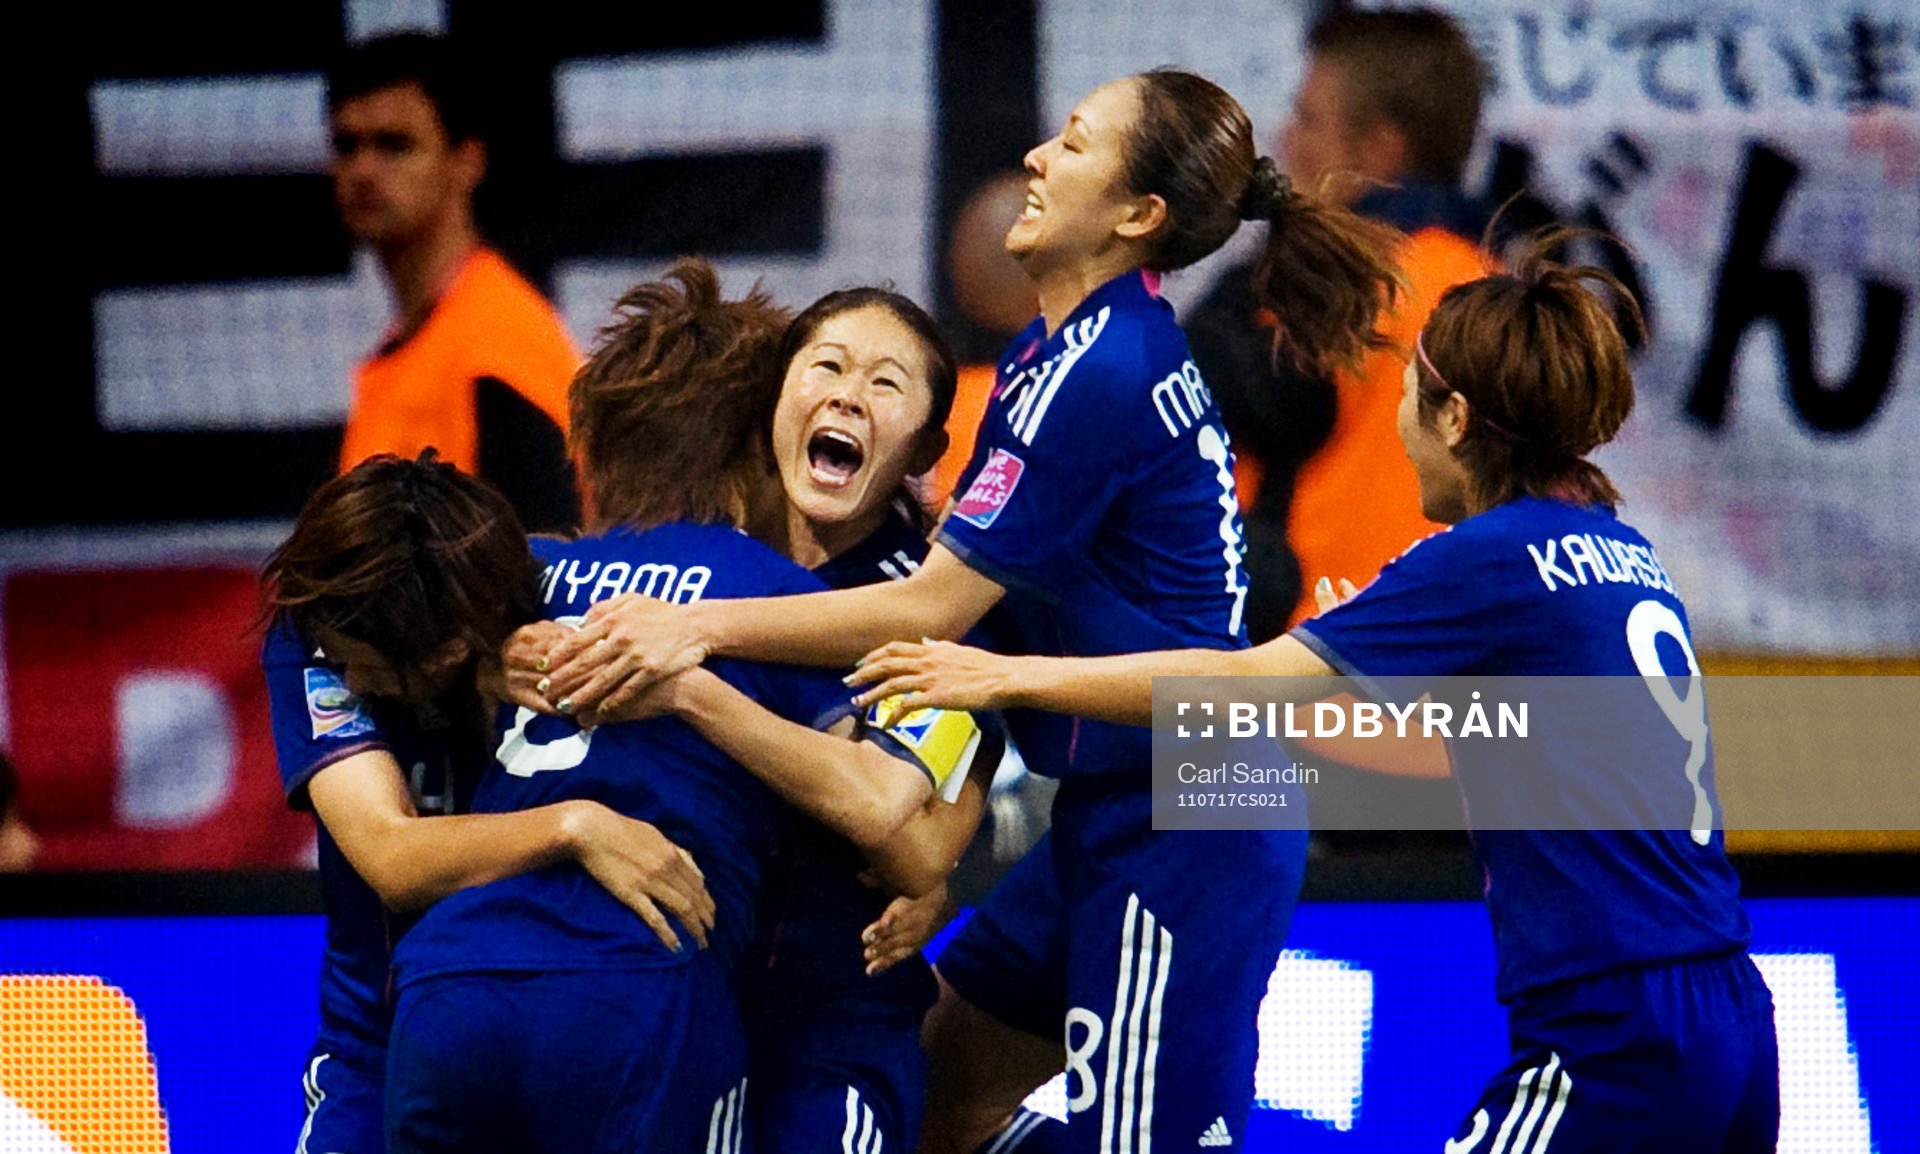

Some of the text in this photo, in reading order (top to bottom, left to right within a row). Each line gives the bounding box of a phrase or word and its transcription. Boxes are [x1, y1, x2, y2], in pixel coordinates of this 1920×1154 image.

[1152, 360, 1212, 438] MA
[537, 558, 713, 605] IYAMA
[1625, 599, 1714, 847] 9
